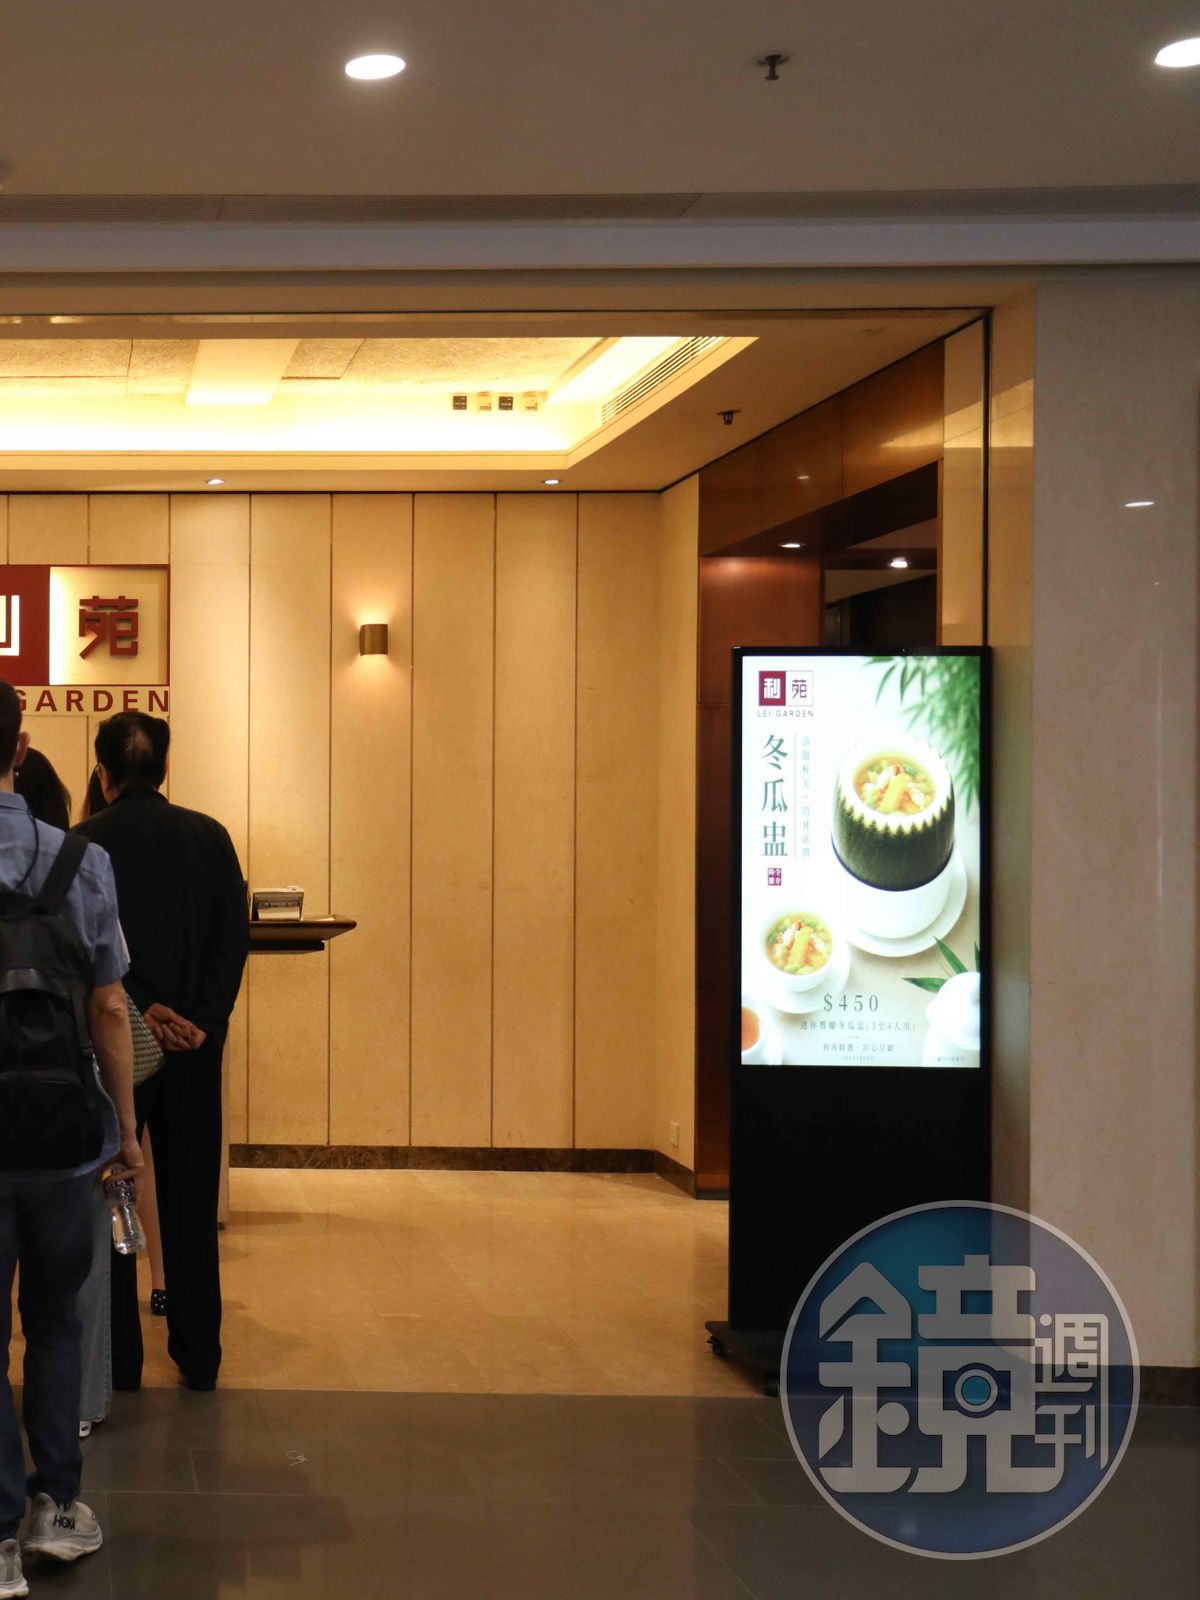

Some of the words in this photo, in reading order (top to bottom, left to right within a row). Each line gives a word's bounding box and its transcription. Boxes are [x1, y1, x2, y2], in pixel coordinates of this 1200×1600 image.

[763, 678, 807, 699] 利苑
[757, 710, 771, 718] LEI
[776, 710, 814, 718] GARDEN
[760, 734, 789, 857] 冬瓜盅
[823, 992, 879, 1012] $450
